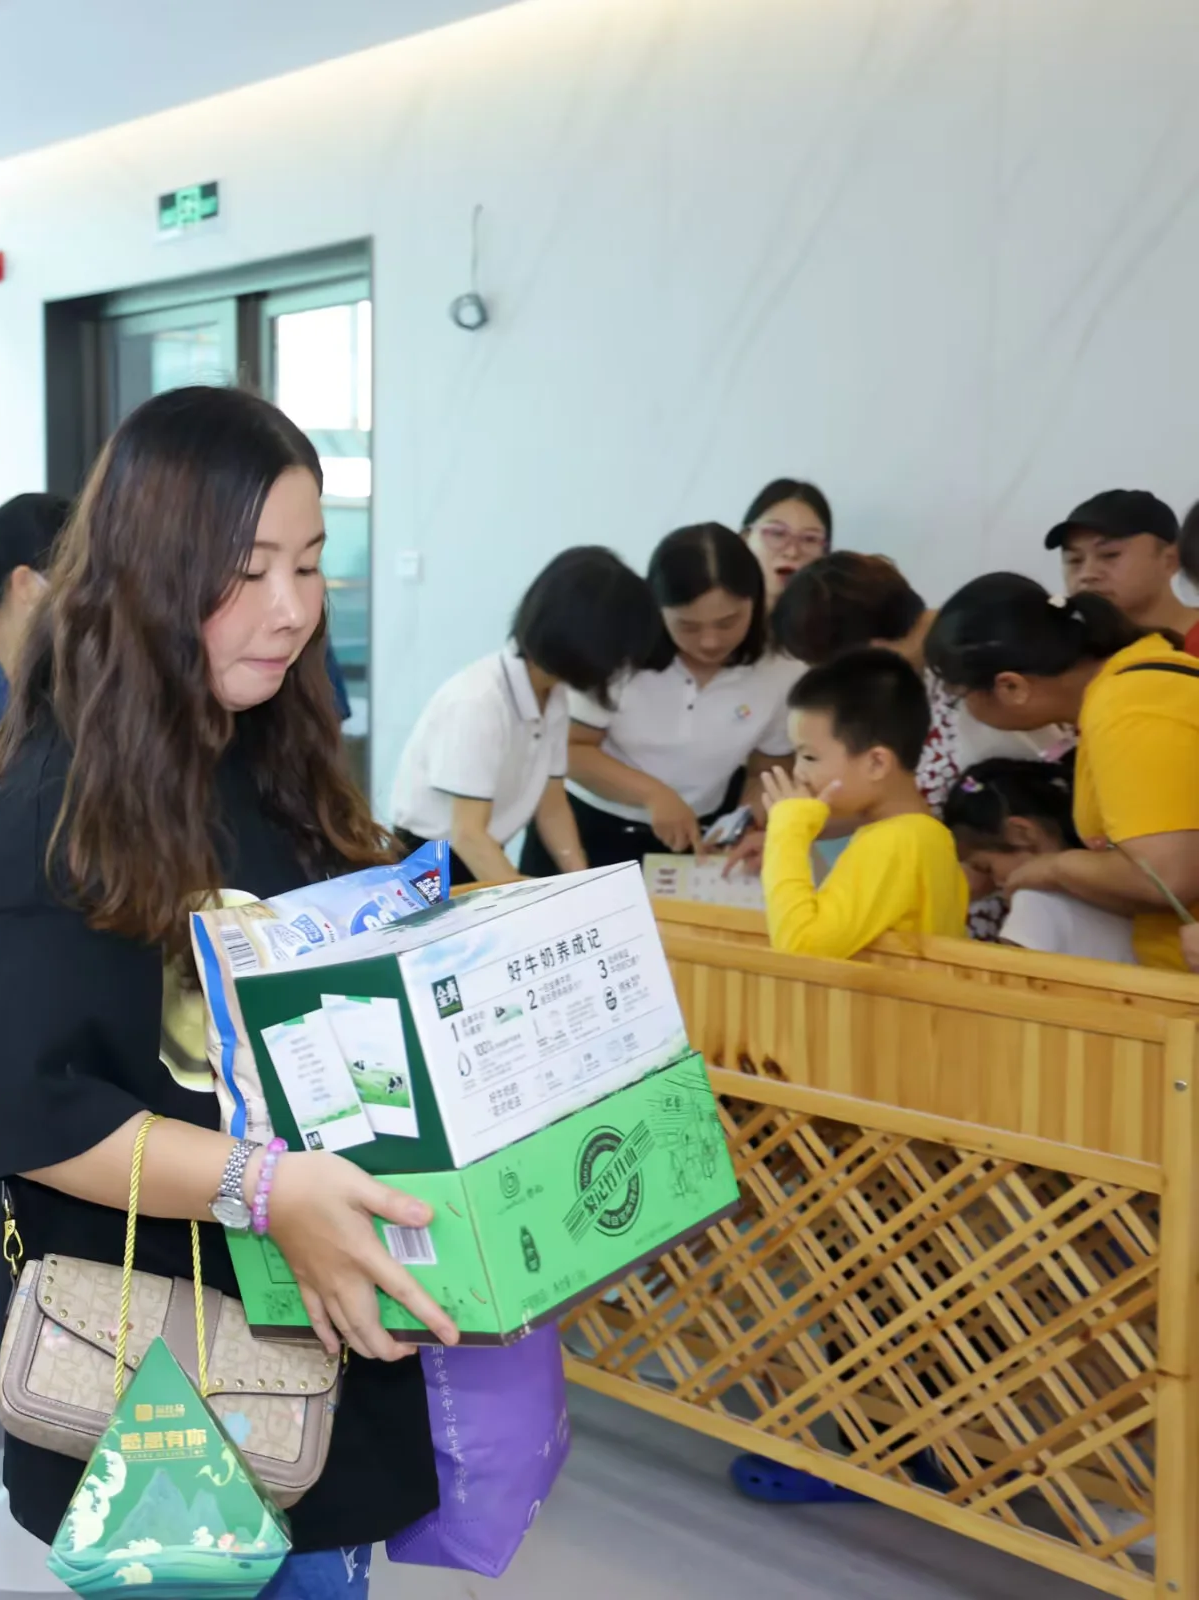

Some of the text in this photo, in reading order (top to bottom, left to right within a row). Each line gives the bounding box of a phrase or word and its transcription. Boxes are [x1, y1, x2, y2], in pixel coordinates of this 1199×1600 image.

[507, 927, 602, 982] 好牛奶养成记
[597, 959, 608, 979] 3
[435, 979, 462, 1009] 金典
[526, 988, 539, 1011] 2
[450, 1021, 460, 1043] 1
